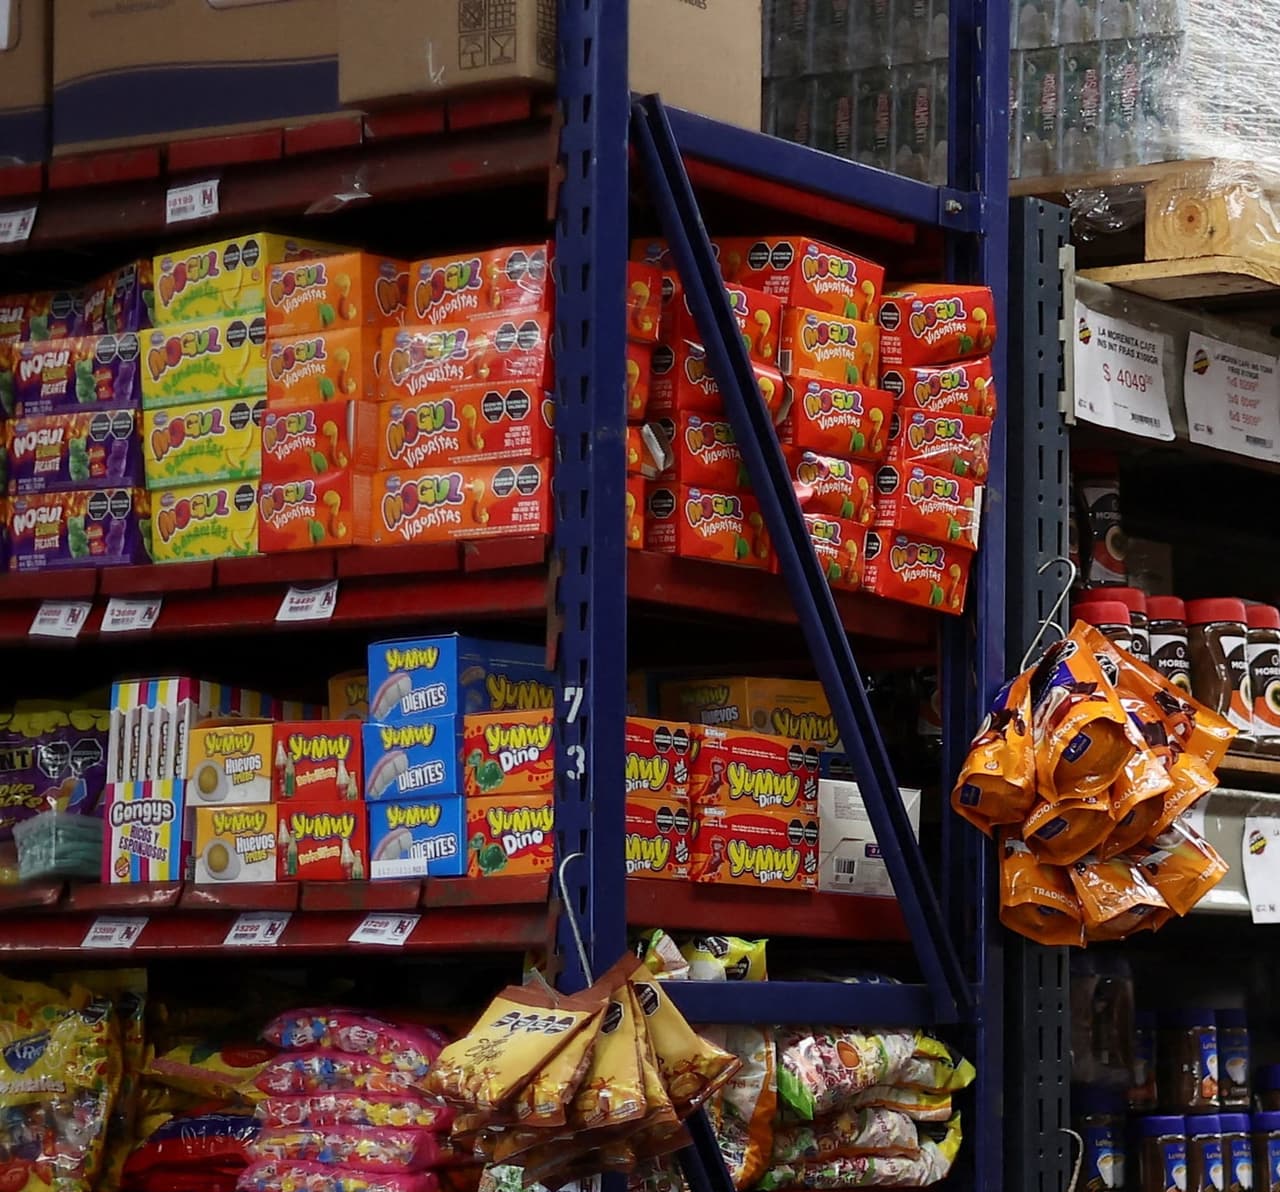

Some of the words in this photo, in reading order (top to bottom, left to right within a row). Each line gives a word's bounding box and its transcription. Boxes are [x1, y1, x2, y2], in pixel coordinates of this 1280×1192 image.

[157, 250, 220, 307] MOGUL
[269, 263, 327, 307] MOGUL
[415, 258, 483, 319] MOGUL
[283, 288, 326, 315] VIBORITAS
[428, 294, 478, 325] VIBORITAS
[1097, 327, 1106, 336] LA
[1107, 330, 1138, 347] MORENITA
[148, 327, 223, 383] MOGUL
[269, 337, 327, 381] MOGUL
[389, 328, 469, 385] MOGUL
[282, 363, 326, 389] VIBORITAS
[406, 363, 464, 396] VIBORITAS
[1102, 363, 1111, 382] $
[1117, 369, 1146, 392] 4049
[803, 388, 864, 420] MOGUL
[151, 408, 226, 461] MOGUL
[263, 410, 317, 453] MOGUL
[387, 399, 460, 460] MOGUL
[686, 420, 737, 455] MOGU
[274, 436, 316, 461] VIBORITAS
[403, 437, 459, 469] VIBORITAS
[702, 447, 742, 467] VIBORITA
[260, 480, 317, 522] MOGUL
[382, 472, 465, 532] MOGUL
[907, 476, 961, 505] MOGUL
[157, 490, 230, 543] MOGUL
[273, 507, 315, 529] VIBORITAS
[401, 508, 462, 541] VIBORITAS
[686, 494, 744, 527] MOGUL
[805, 519, 841, 544] GUL
[890, 543, 945, 573] MOGUL
[1158, 658, 1189, 668] MOREN
[402, 683, 447, 715] DIENTES
[486, 673, 554, 709] YUMM
[564, 687, 583, 723] 7
[399, 760, 445, 791] DIENTES
[500, 747, 539, 773] Dino
[566, 745, 585, 780] 3
[112, 801, 174, 826] Gongys
[759, 792, 782, 808] Dino
[410, 833, 456, 862] DIENTES
[503, 829, 543, 857] Dino
[759, 869, 782, 884] Dino
